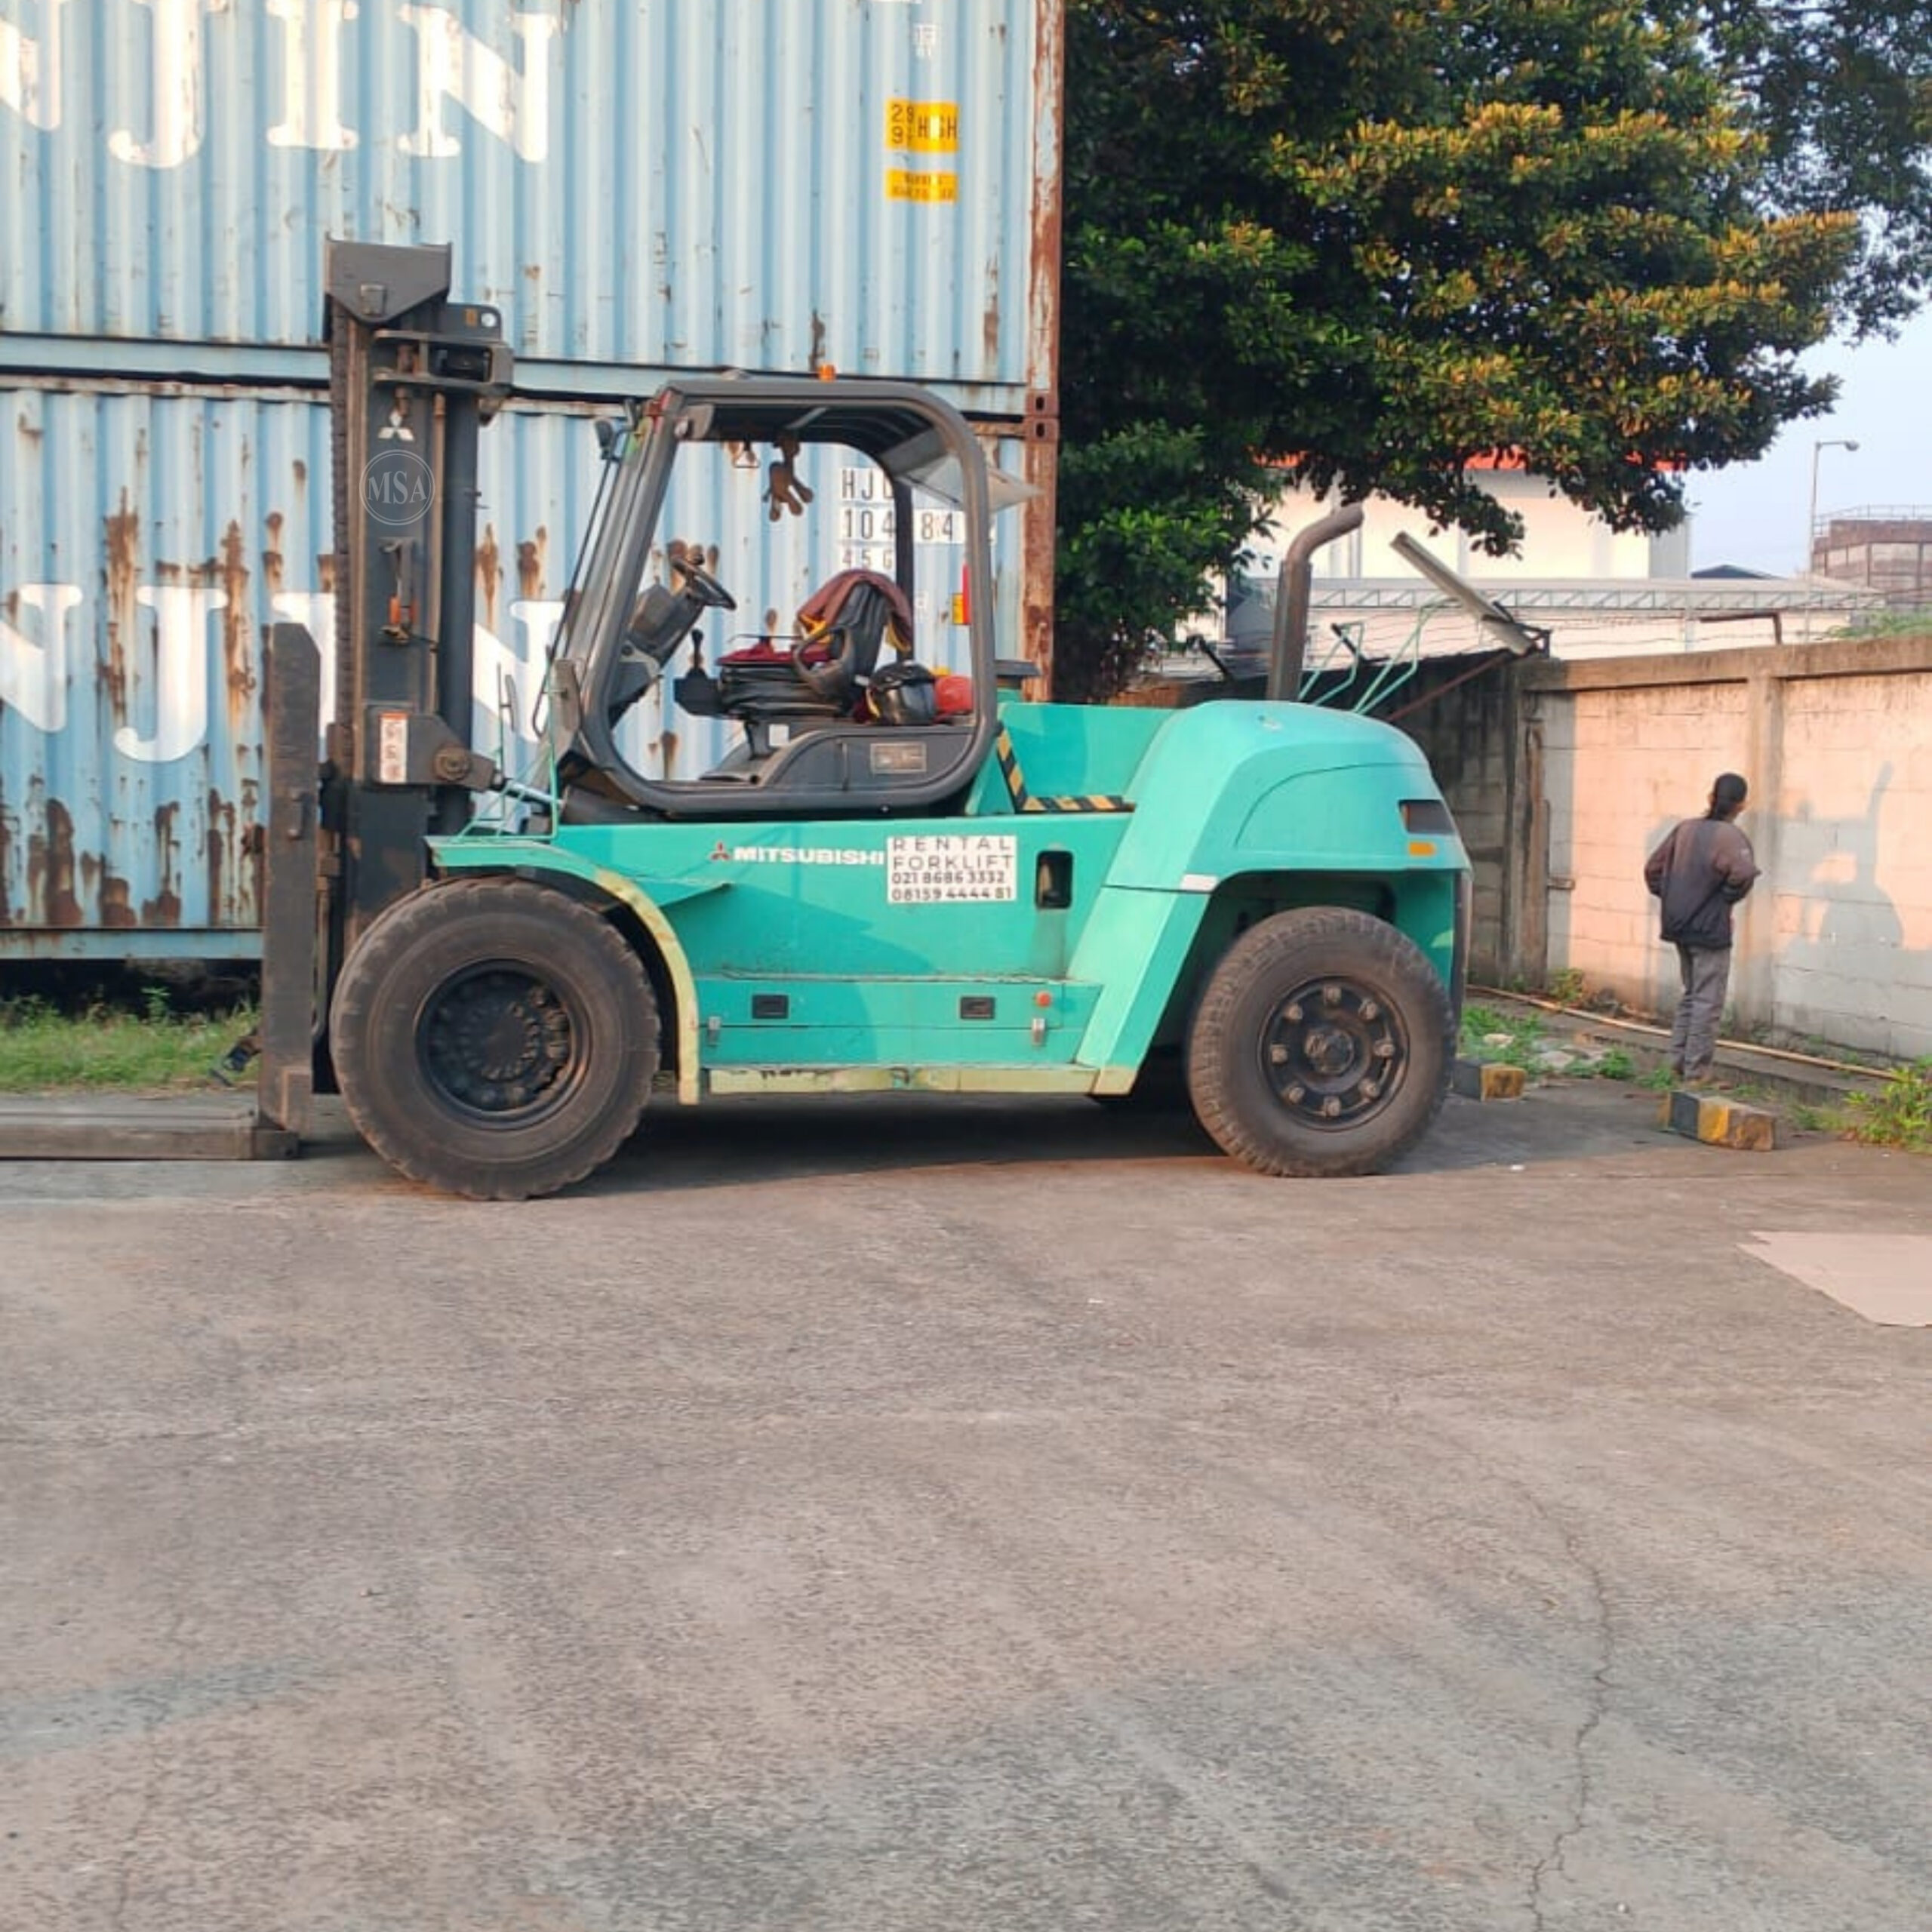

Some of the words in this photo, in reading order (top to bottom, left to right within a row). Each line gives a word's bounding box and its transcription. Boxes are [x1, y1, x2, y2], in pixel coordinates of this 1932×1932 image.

[918, 115, 958, 140] HGH
[893, 837, 1011, 851] RENTAL
[734, 846, 884, 865] MITSUBISHI
[894, 854, 1014, 869] FORKLIFT
[892, 872, 918, 884] 021
